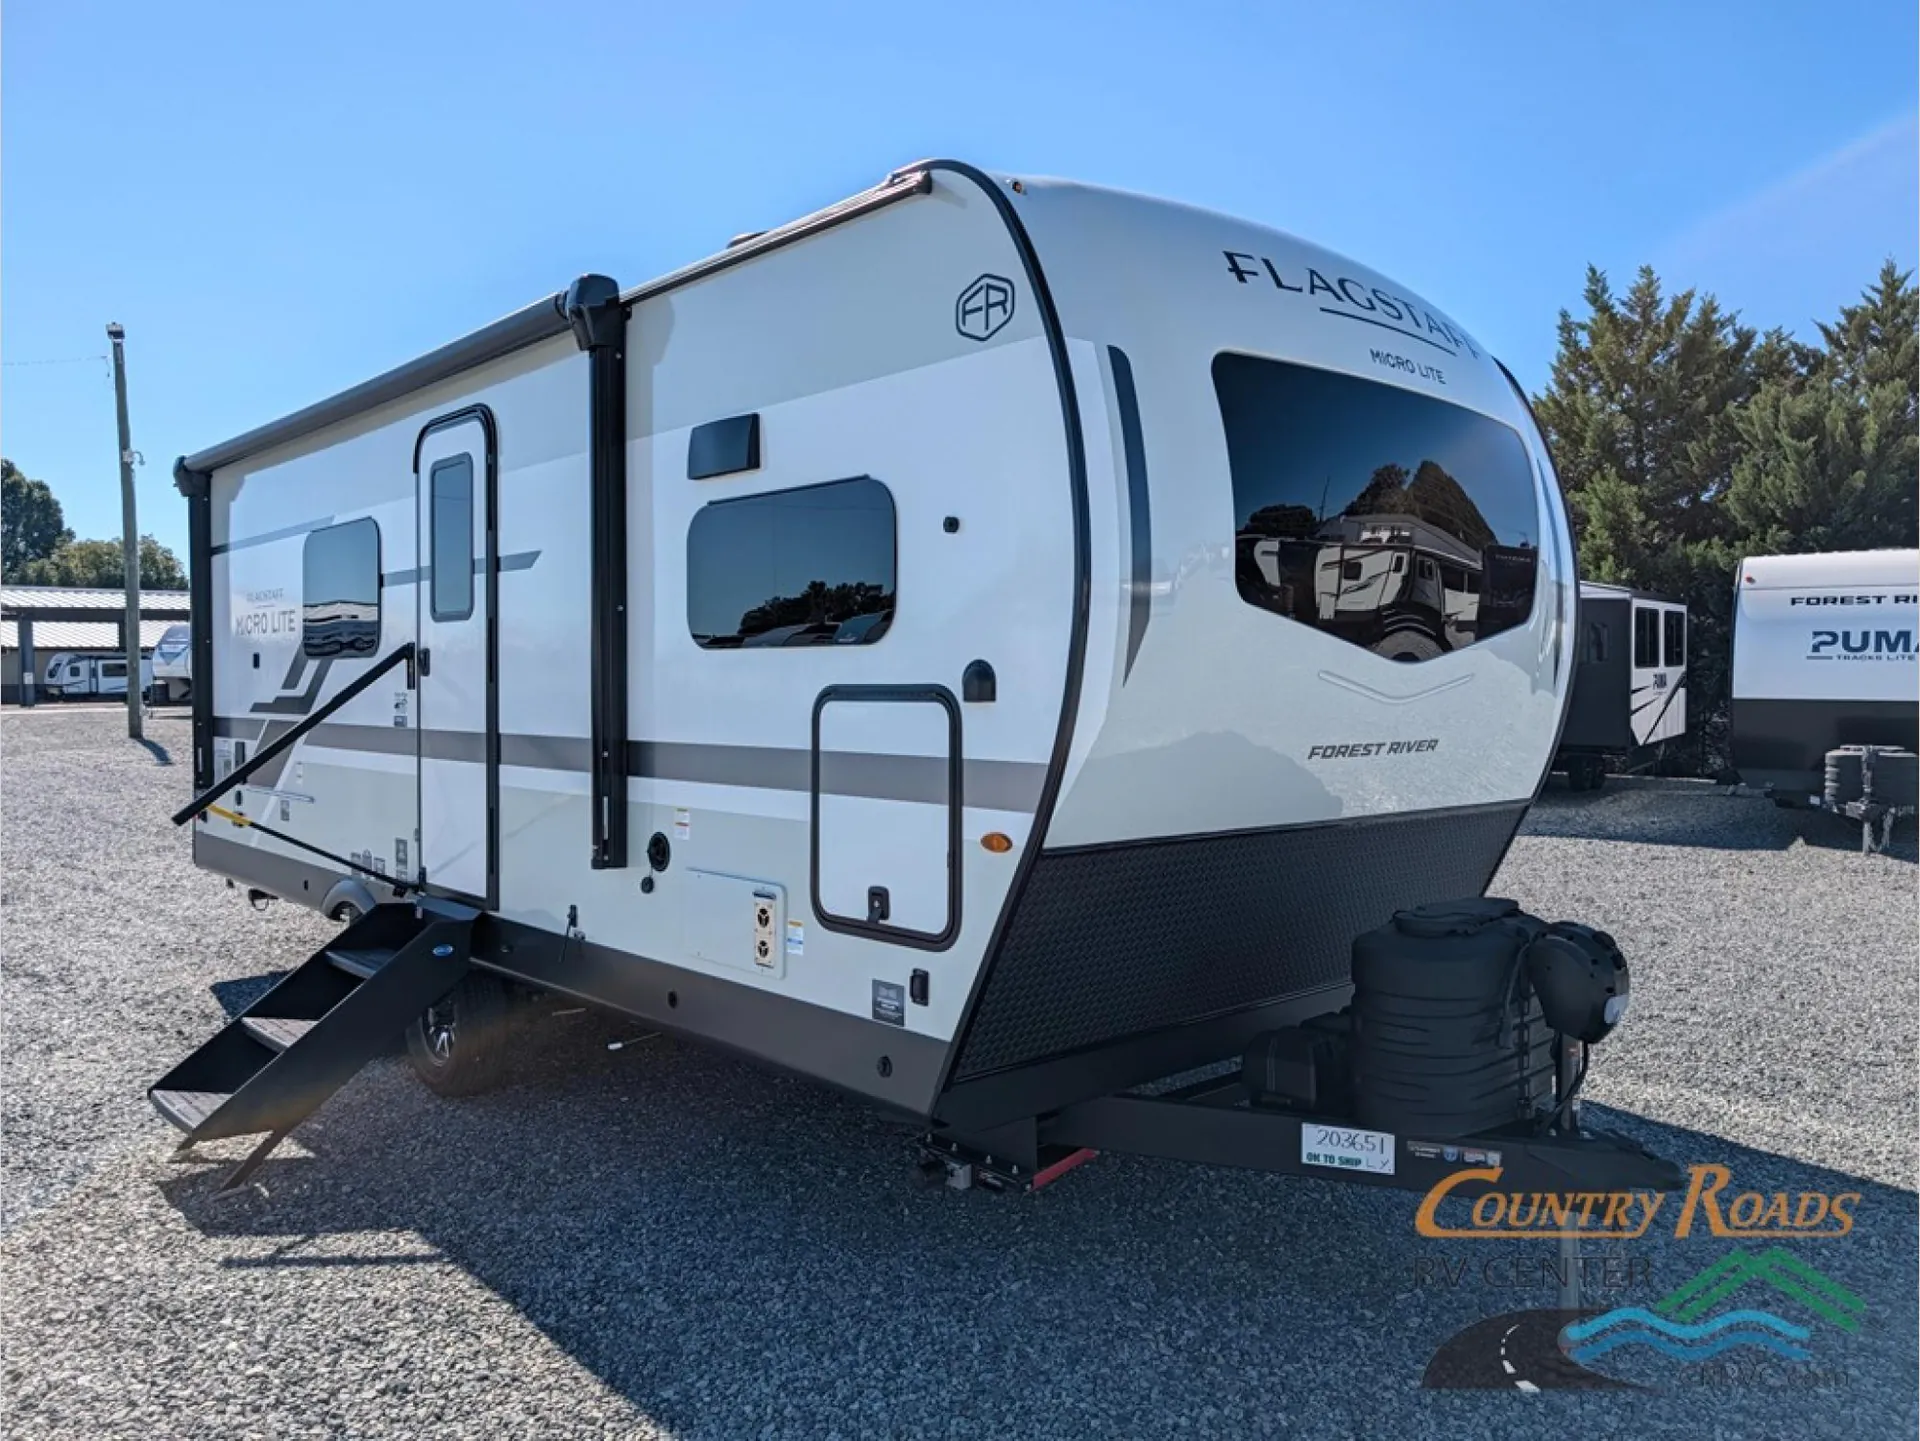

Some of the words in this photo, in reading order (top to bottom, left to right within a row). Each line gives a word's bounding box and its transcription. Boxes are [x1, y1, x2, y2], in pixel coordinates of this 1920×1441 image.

[1224, 251, 1480, 360] FLAGSTAFF
[1369, 348, 1415, 374] MICRO
[1419, 363, 1447, 385] LITE
[1791, 595, 1887, 606] FOREST
[235, 612, 268, 635] MICRO
[272, 609, 296, 633] LITE
[1308, 743, 1386, 759] FOREST
[1387, 740, 1438, 755] RIVER
[1316, 1129, 1384, 1155] 203651
[1306, 1152, 1321, 1163] OK
[1323, 1154, 1336, 1164] TO
[1337, 1156, 1362, 1167] SHIP
